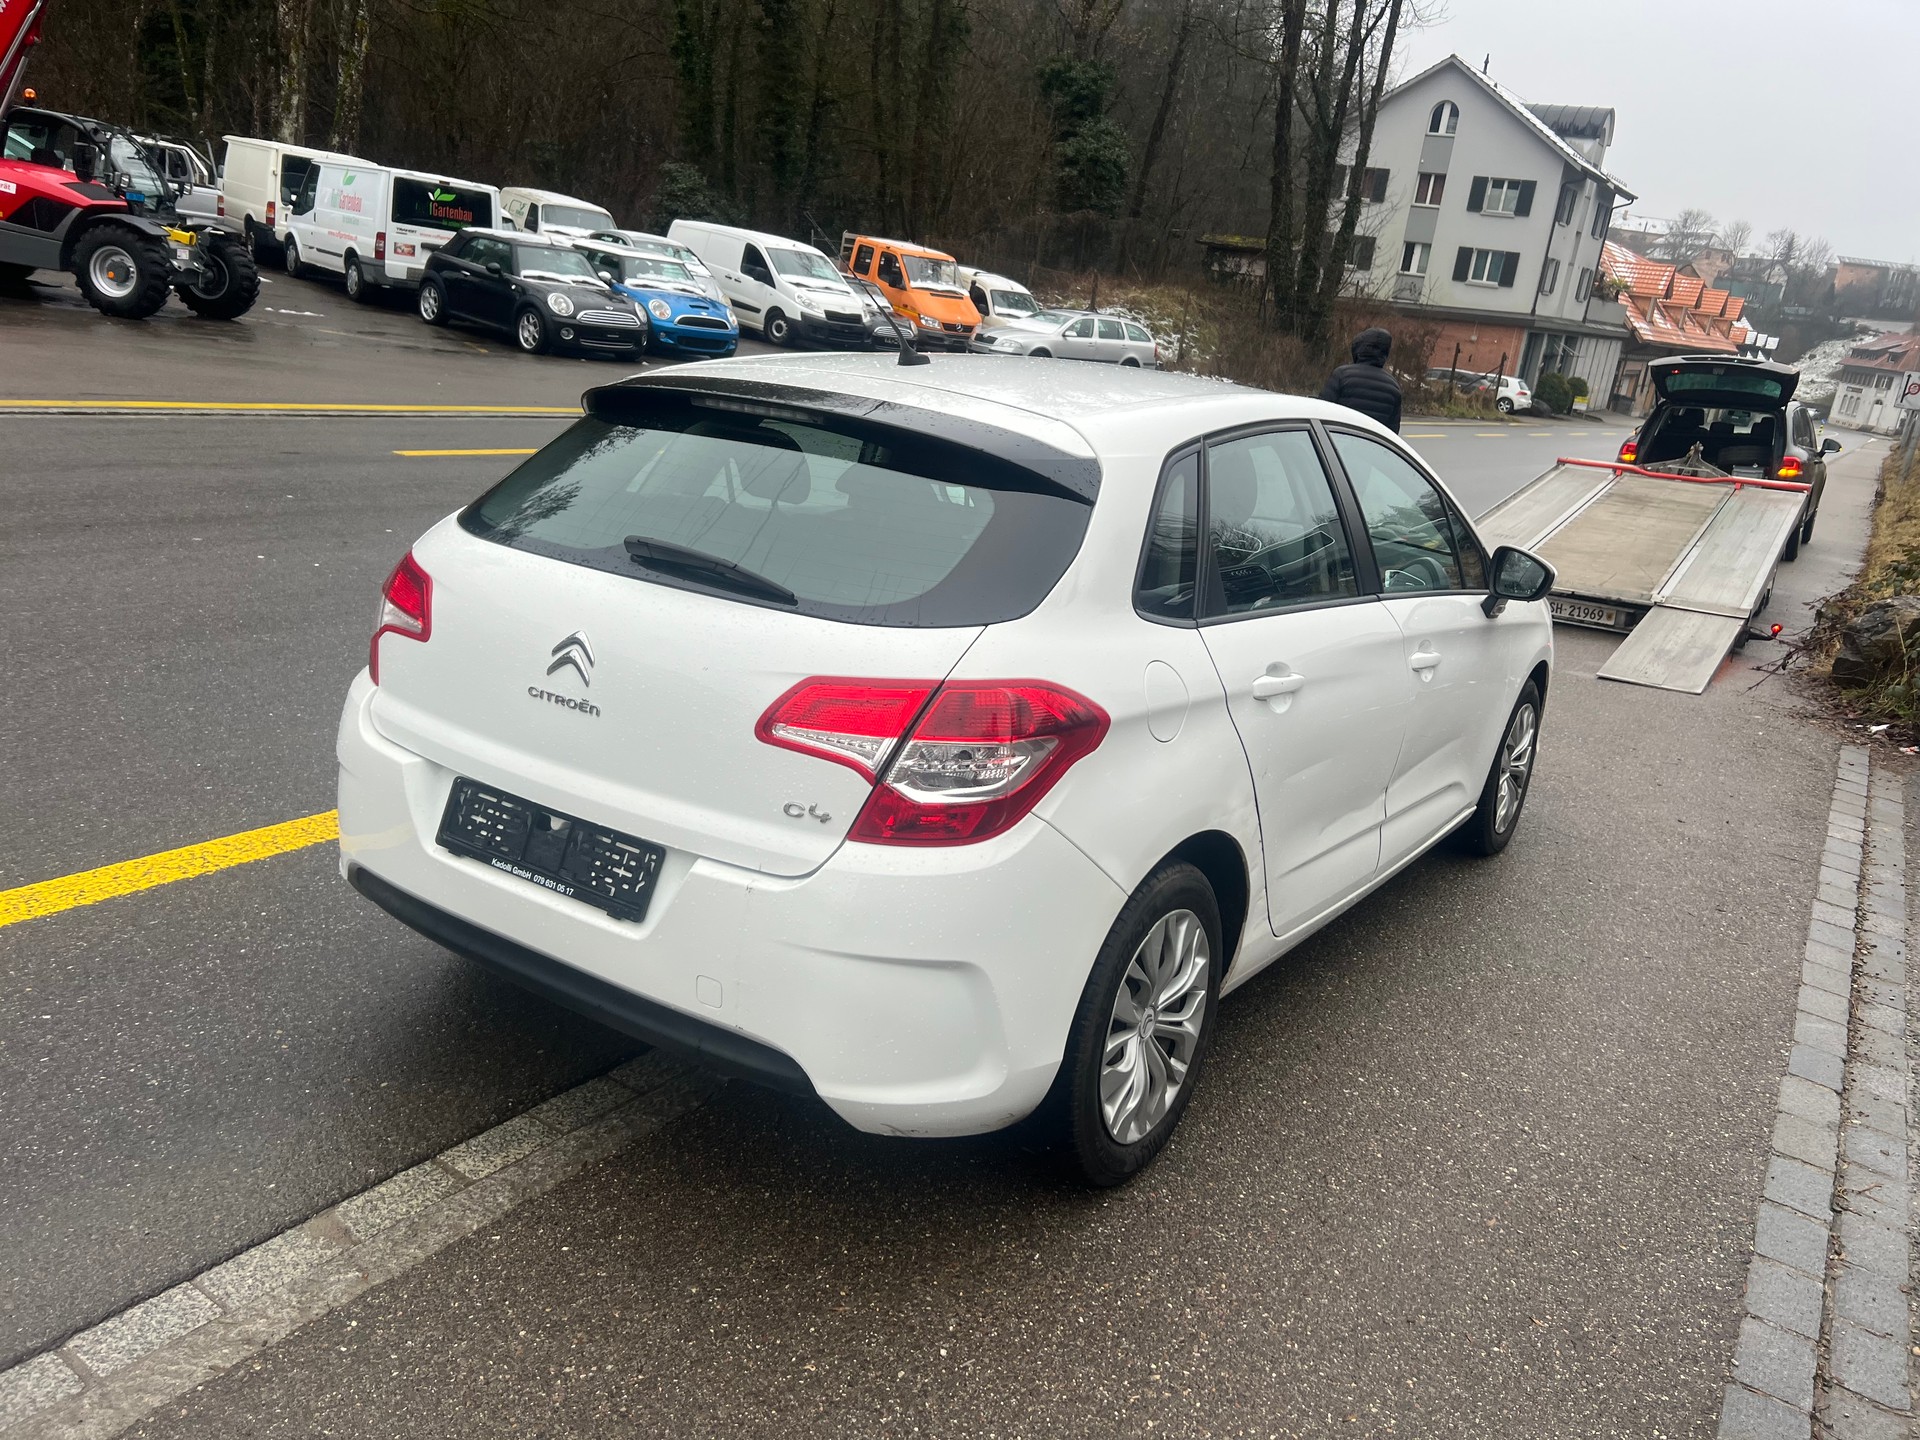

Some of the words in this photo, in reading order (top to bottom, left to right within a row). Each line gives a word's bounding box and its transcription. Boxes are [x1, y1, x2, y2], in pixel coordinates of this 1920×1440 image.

[527, 686, 601, 718] CITROËN
[783, 801, 832, 824] C4
[512, 866, 532, 880] GmbH
[533, 874, 545, 885] 079
[545, 879, 557, 890] 631
[565, 887, 574, 896] 17
